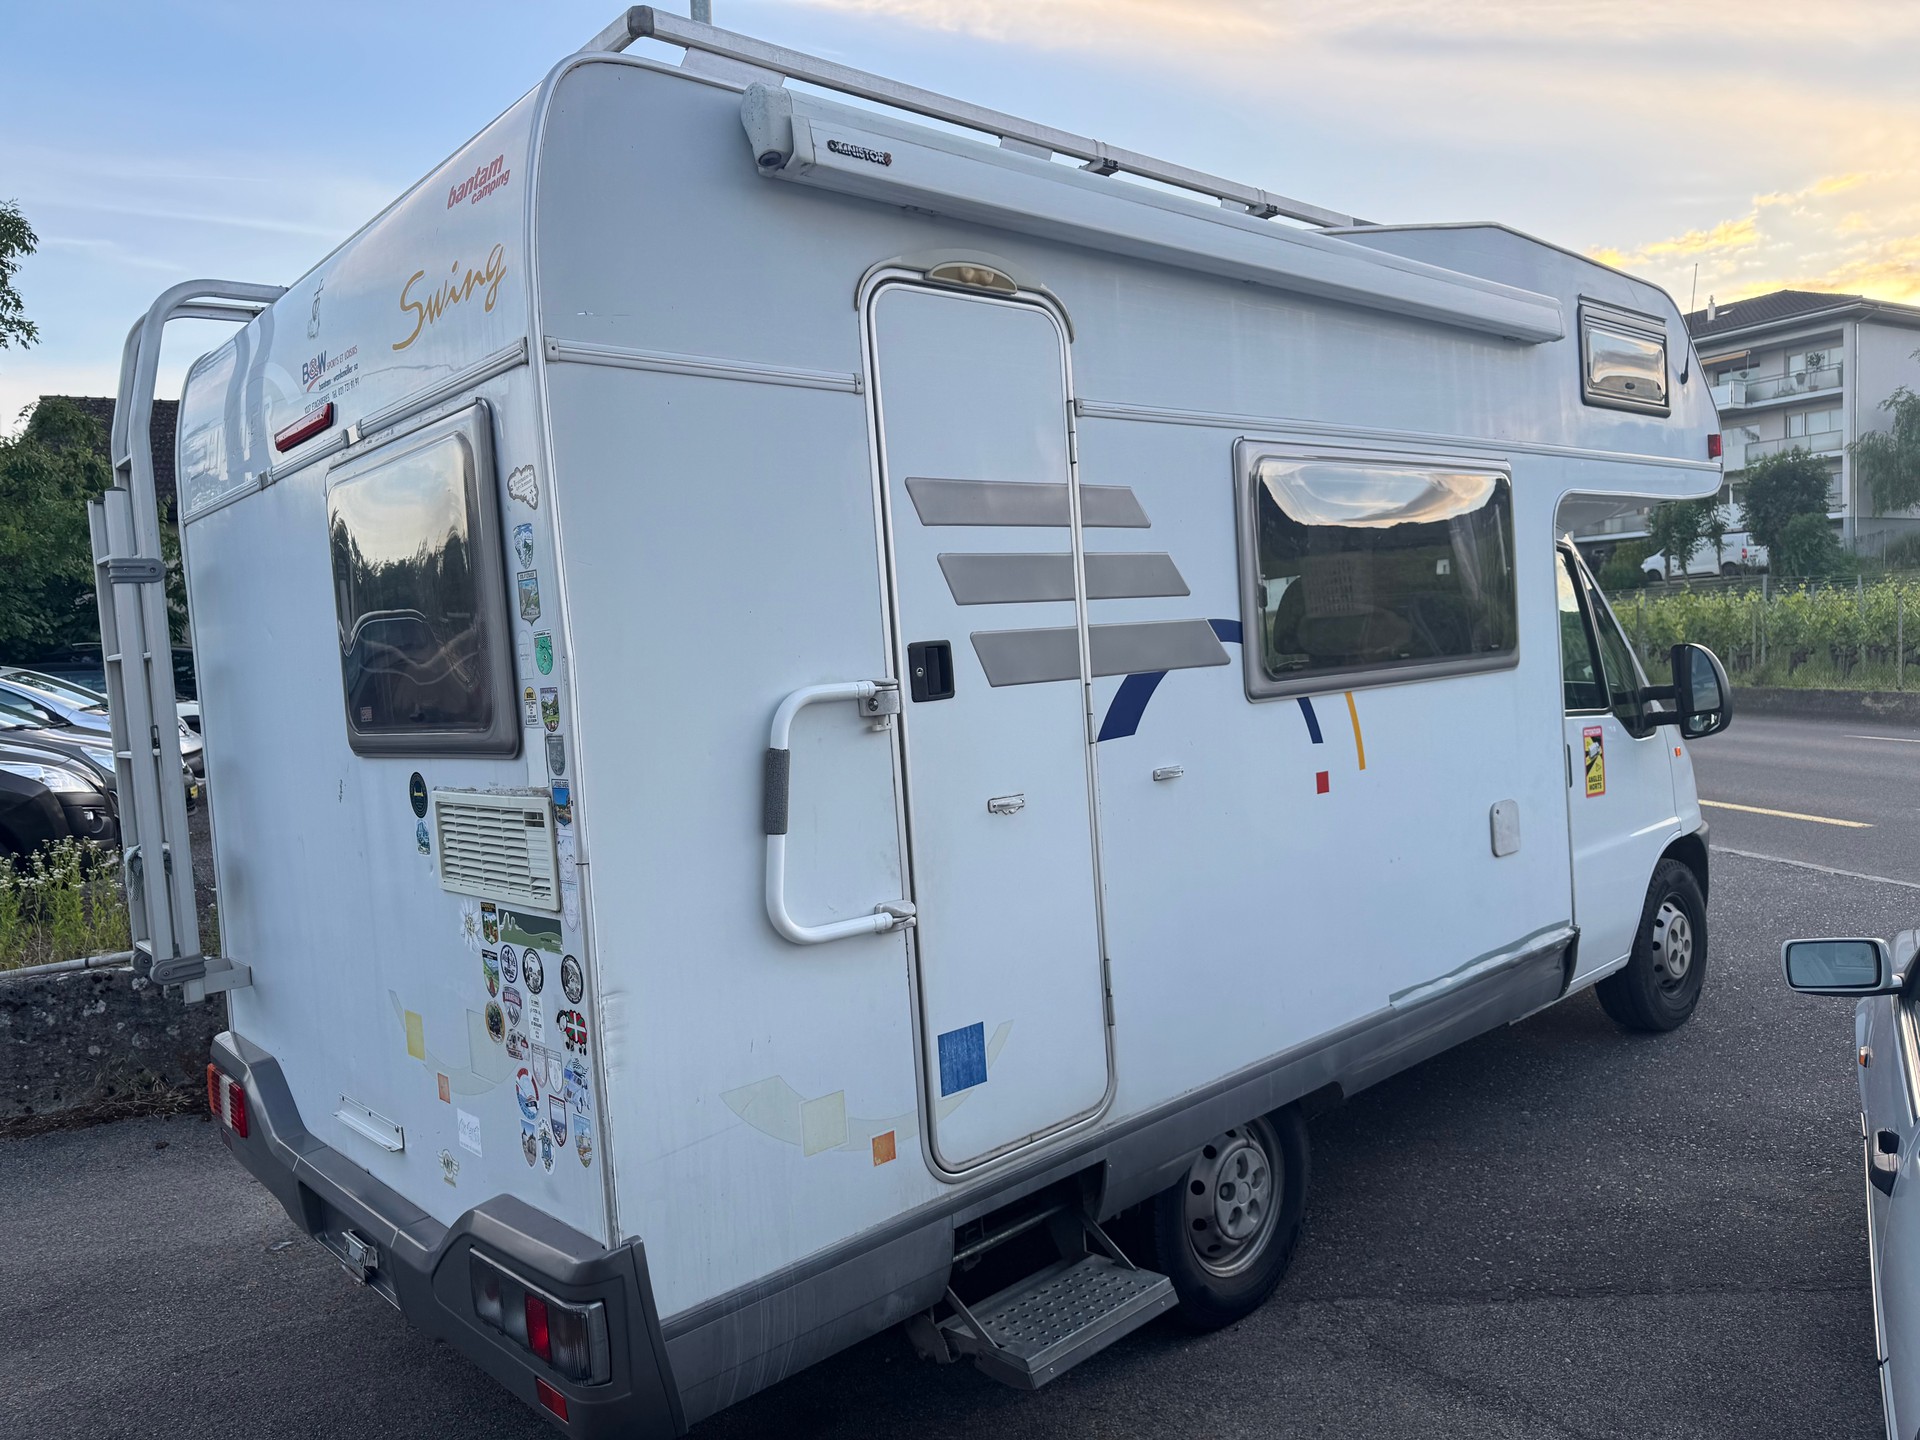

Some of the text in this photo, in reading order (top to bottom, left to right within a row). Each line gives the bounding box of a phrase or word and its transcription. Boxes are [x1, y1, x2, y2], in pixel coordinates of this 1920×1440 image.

[447, 154, 504, 210] bantam
[472, 169, 511, 204] camping
[392, 243, 507, 351] Swing
[302, 350, 327, 386] B&W
[326, 355, 339, 371] SPORTS
[1588, 774, 1602, 783] ANGLES
[1588, 782, 1602, 791] MORTS
